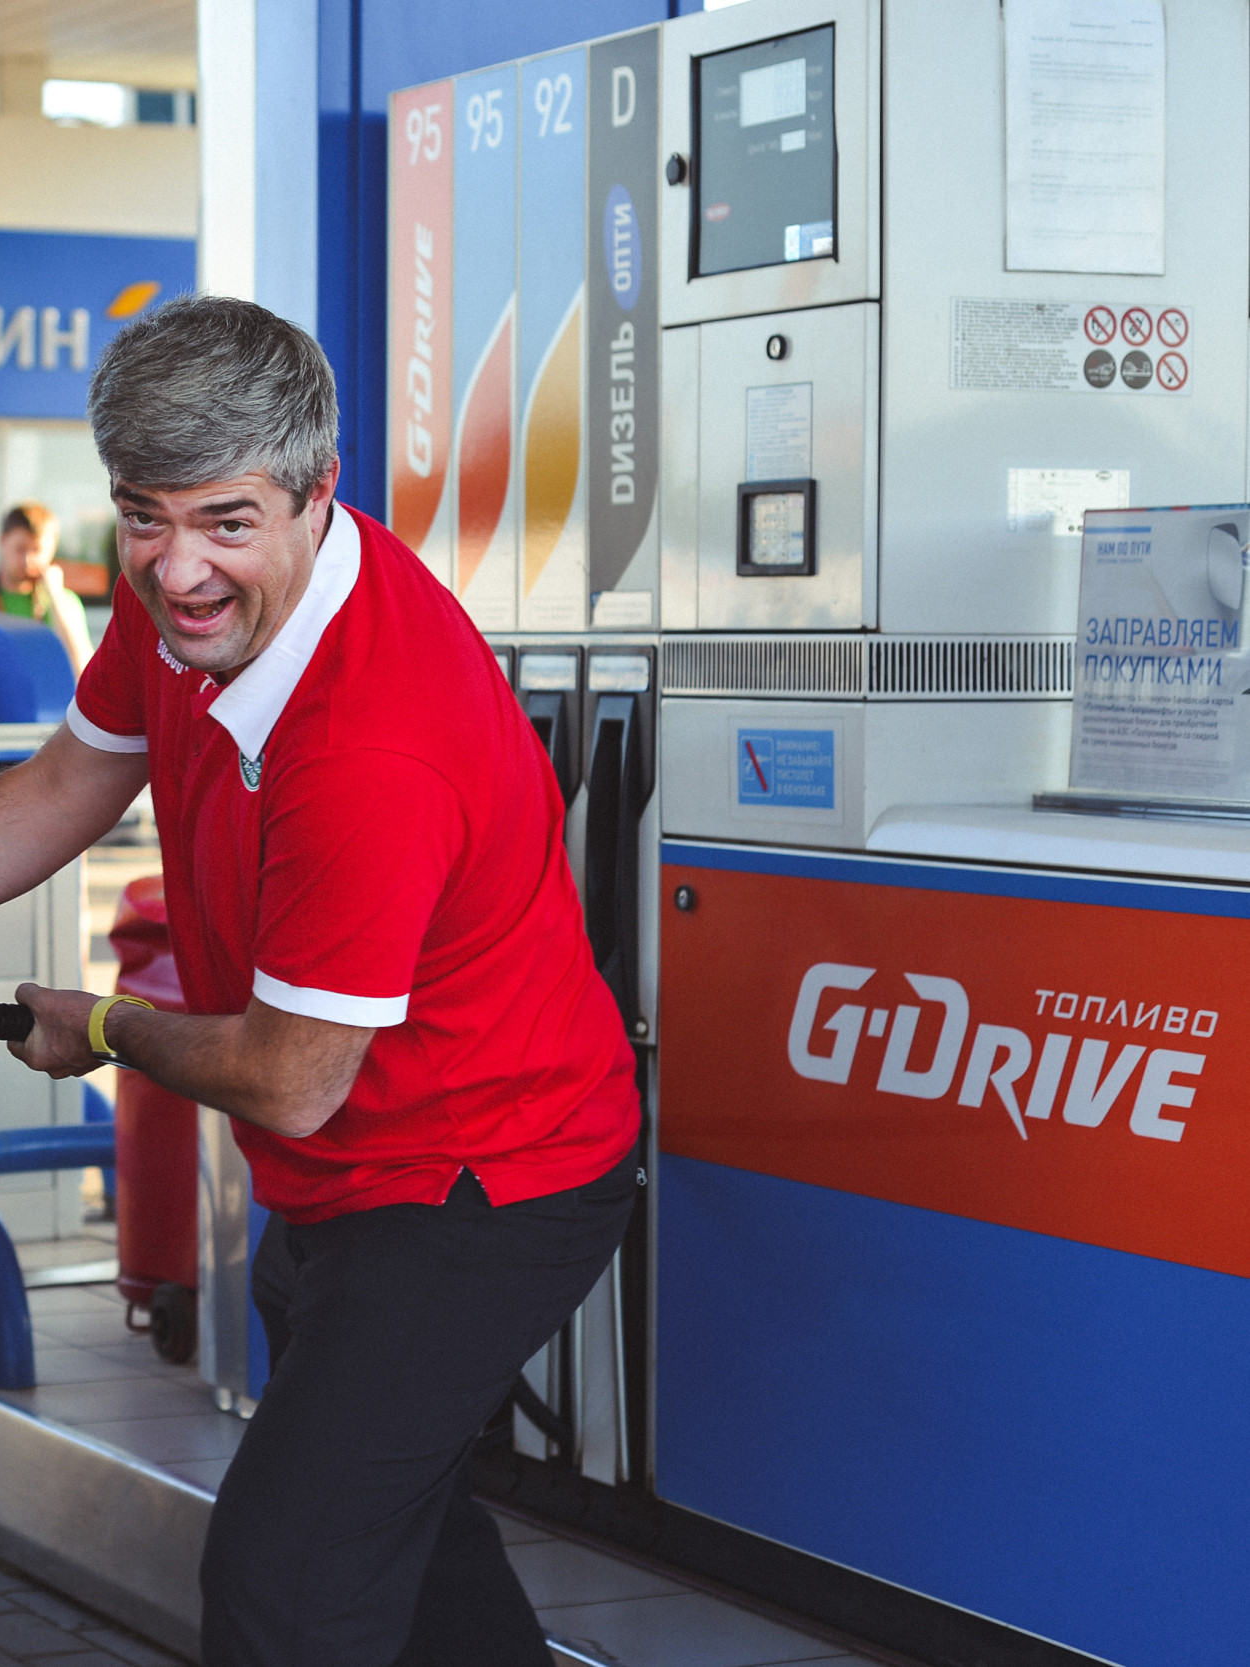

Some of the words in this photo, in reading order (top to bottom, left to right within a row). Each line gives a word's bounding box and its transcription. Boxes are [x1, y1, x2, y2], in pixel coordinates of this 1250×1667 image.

[466, 89, 503, 152] 95
[535, 73, 573, 137] 92
[611, 65, 636, 127] D
[405, 103, 442, 166] 95
[614, 203, 631, 292] ОПТИ
[1097, 542, 1116, 556] НАМ
[1129, 541, 1152, 556] ПУТИ
[1086, 618, 1239, 649] ЗАПРАВЛЯЕМ
[1084, 655, 1222, 686] ПОКУПКАМИ
[1035, 989, 1219, 1038] ТОПЛИВО
